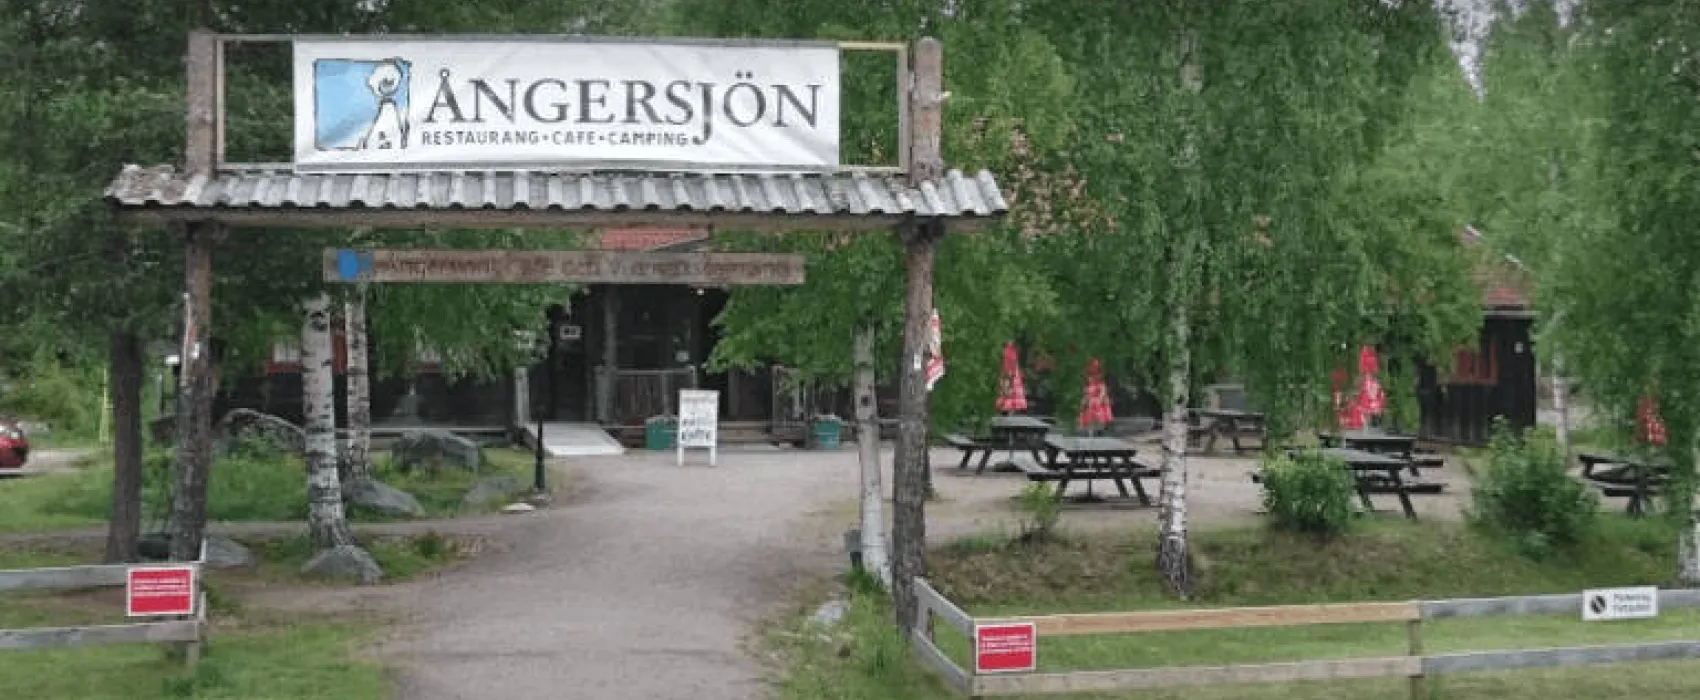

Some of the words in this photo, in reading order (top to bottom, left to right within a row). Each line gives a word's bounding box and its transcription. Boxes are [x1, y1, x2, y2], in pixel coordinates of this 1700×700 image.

[422, 67, 823, 146] ÅNGERSJÖN
[422, 130, 539, 146] RESTAURANG
[608, 131, 689, 147] CAMPING
